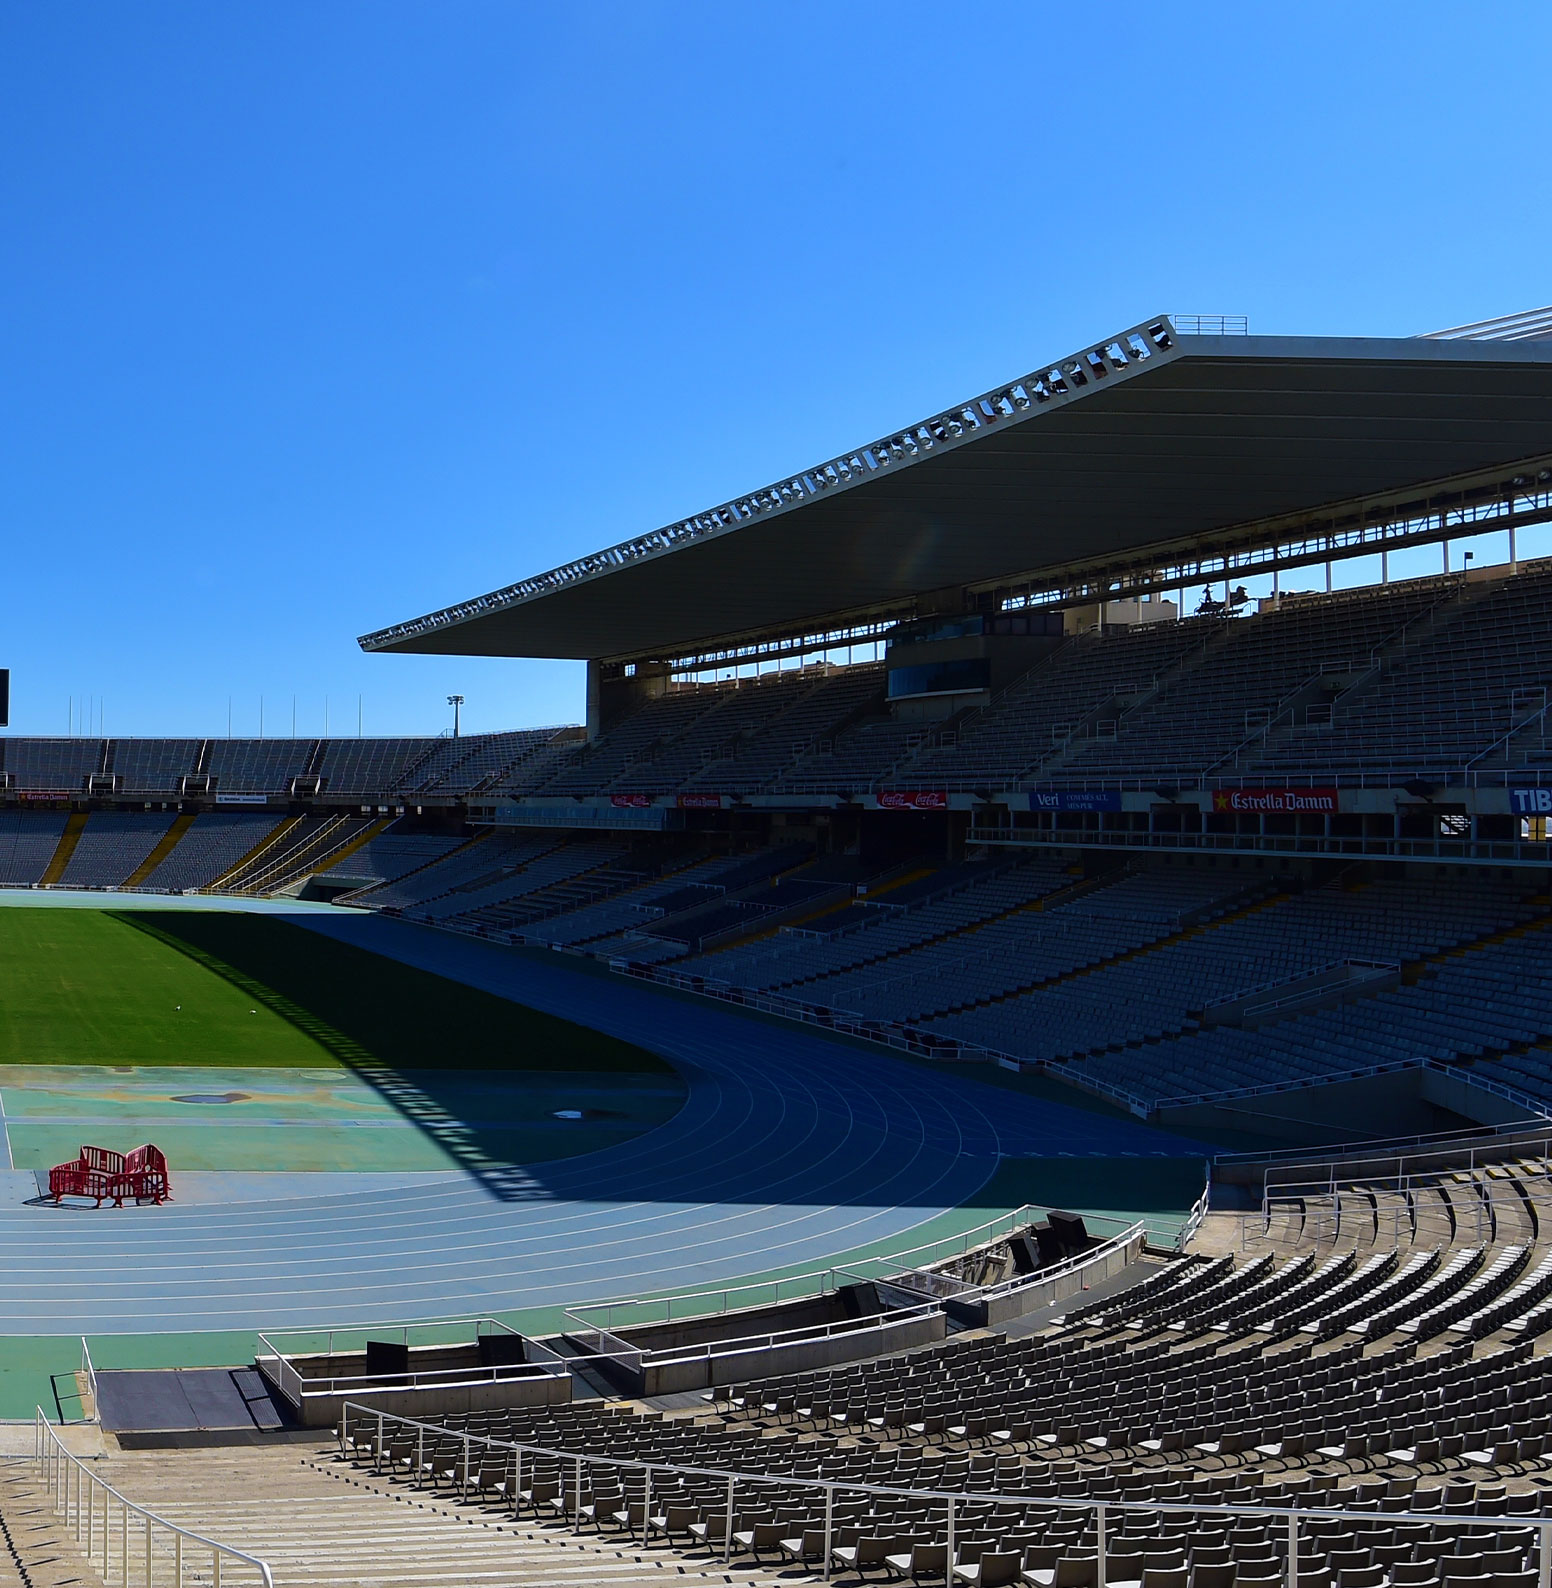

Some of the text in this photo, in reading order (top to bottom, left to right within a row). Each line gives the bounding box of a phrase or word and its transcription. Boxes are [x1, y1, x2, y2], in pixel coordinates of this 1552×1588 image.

[1037, 793, 1060, 806] Veri
[1231, 792, 1333, 811] Estrella Damm
